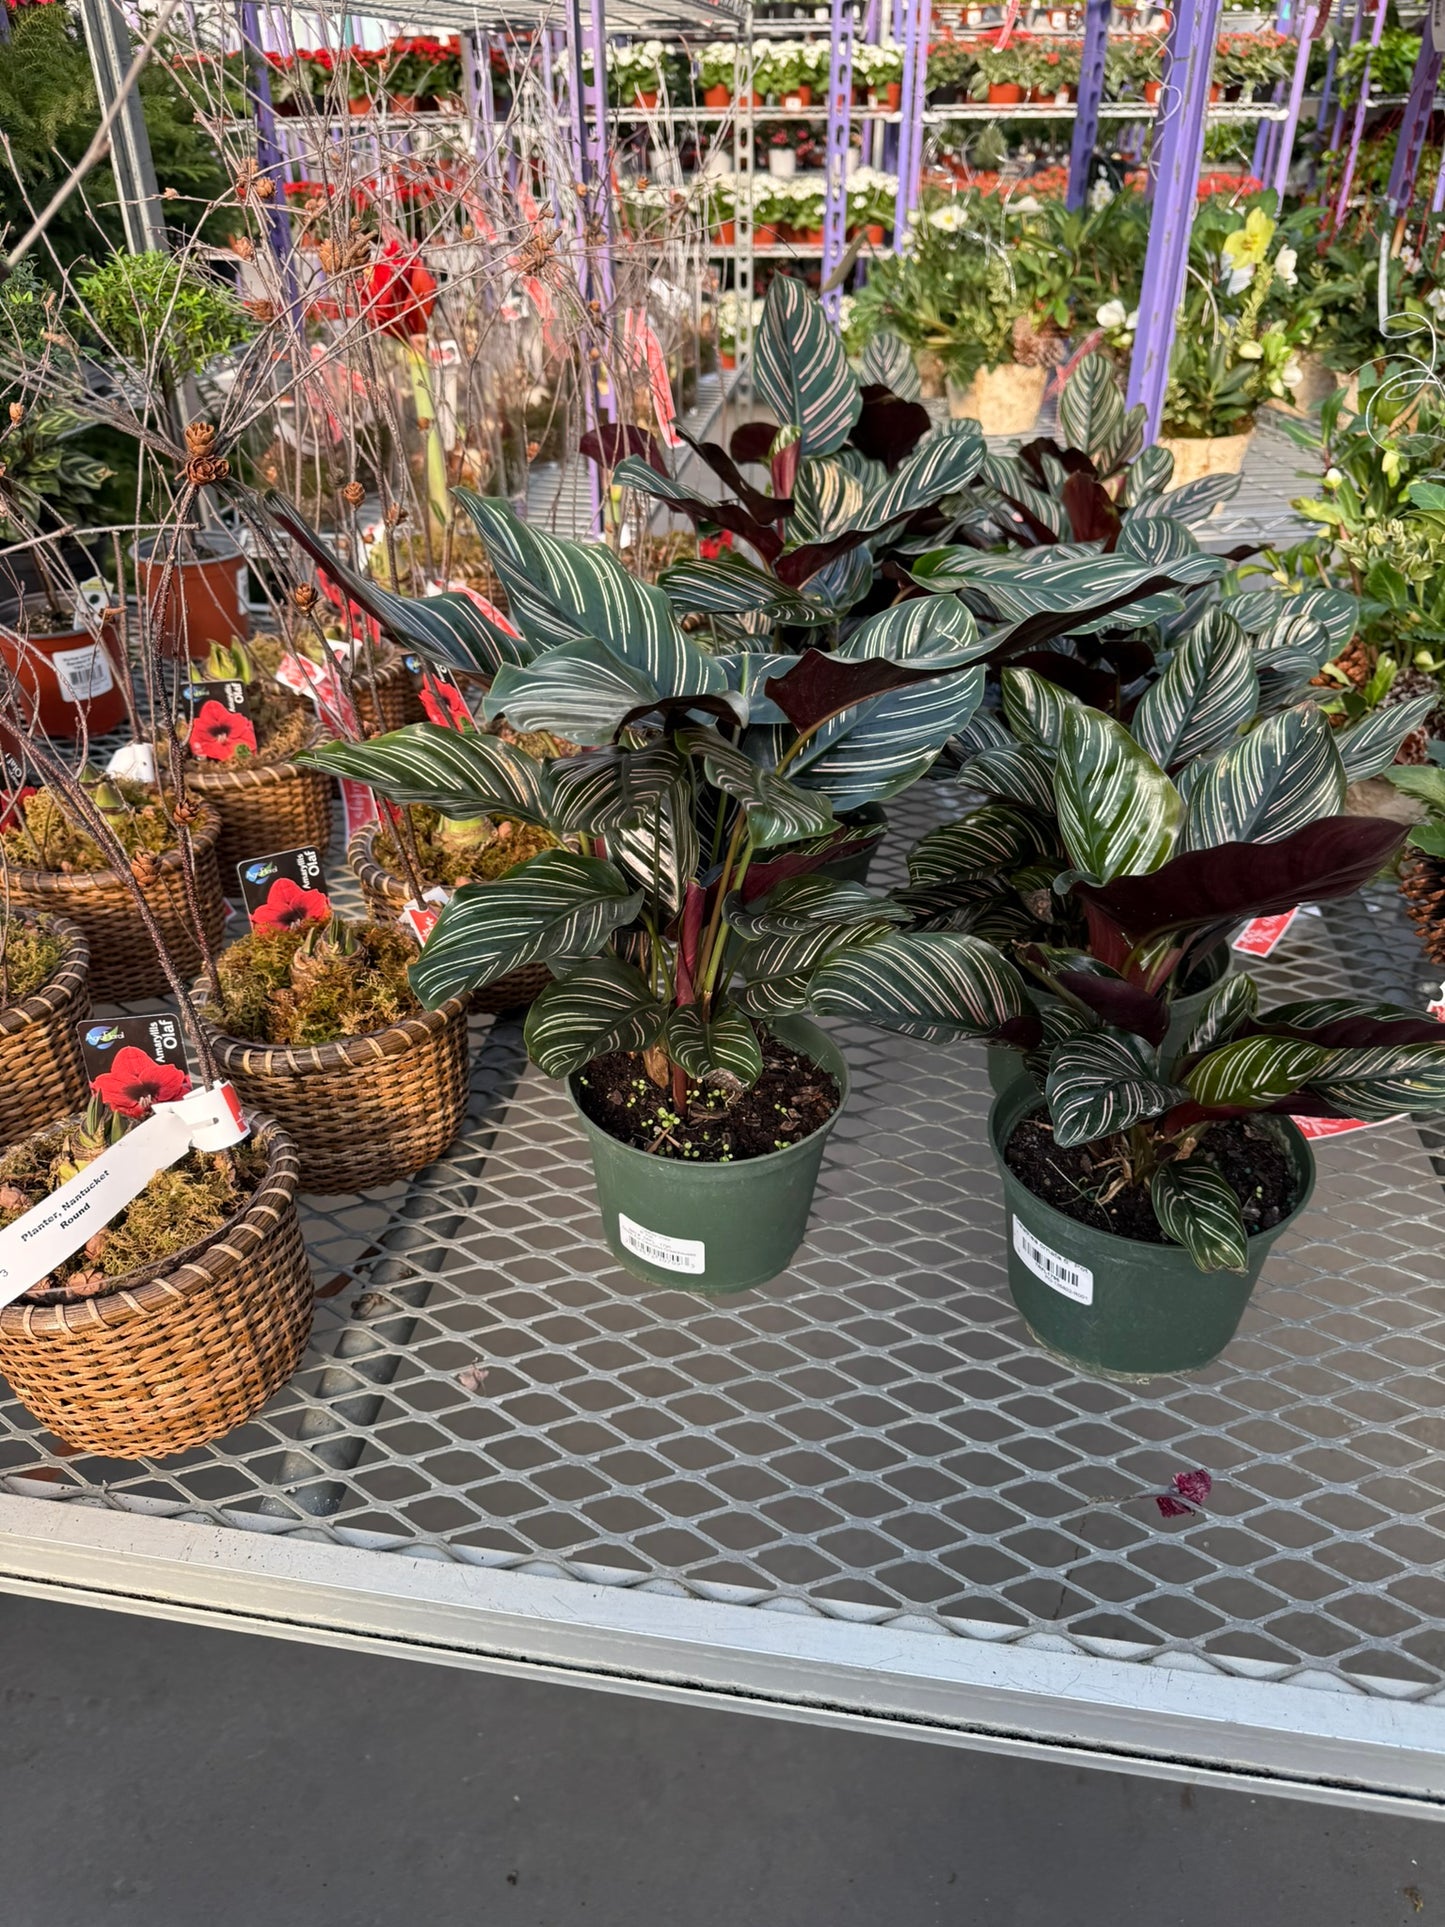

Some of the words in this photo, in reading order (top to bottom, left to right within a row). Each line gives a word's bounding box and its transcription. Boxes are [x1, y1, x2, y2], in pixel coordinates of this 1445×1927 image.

[304, 850, 320, 877] Olaf
[148, 1021, 166, 1063] Amaryllis
[158, 1019, 178, 1050] Olaf
[20, 1209, 63, 1243] Planter,
[61, 1168, 111, 1212] Nantucket
[59, 1202, 92, 1230] Round
